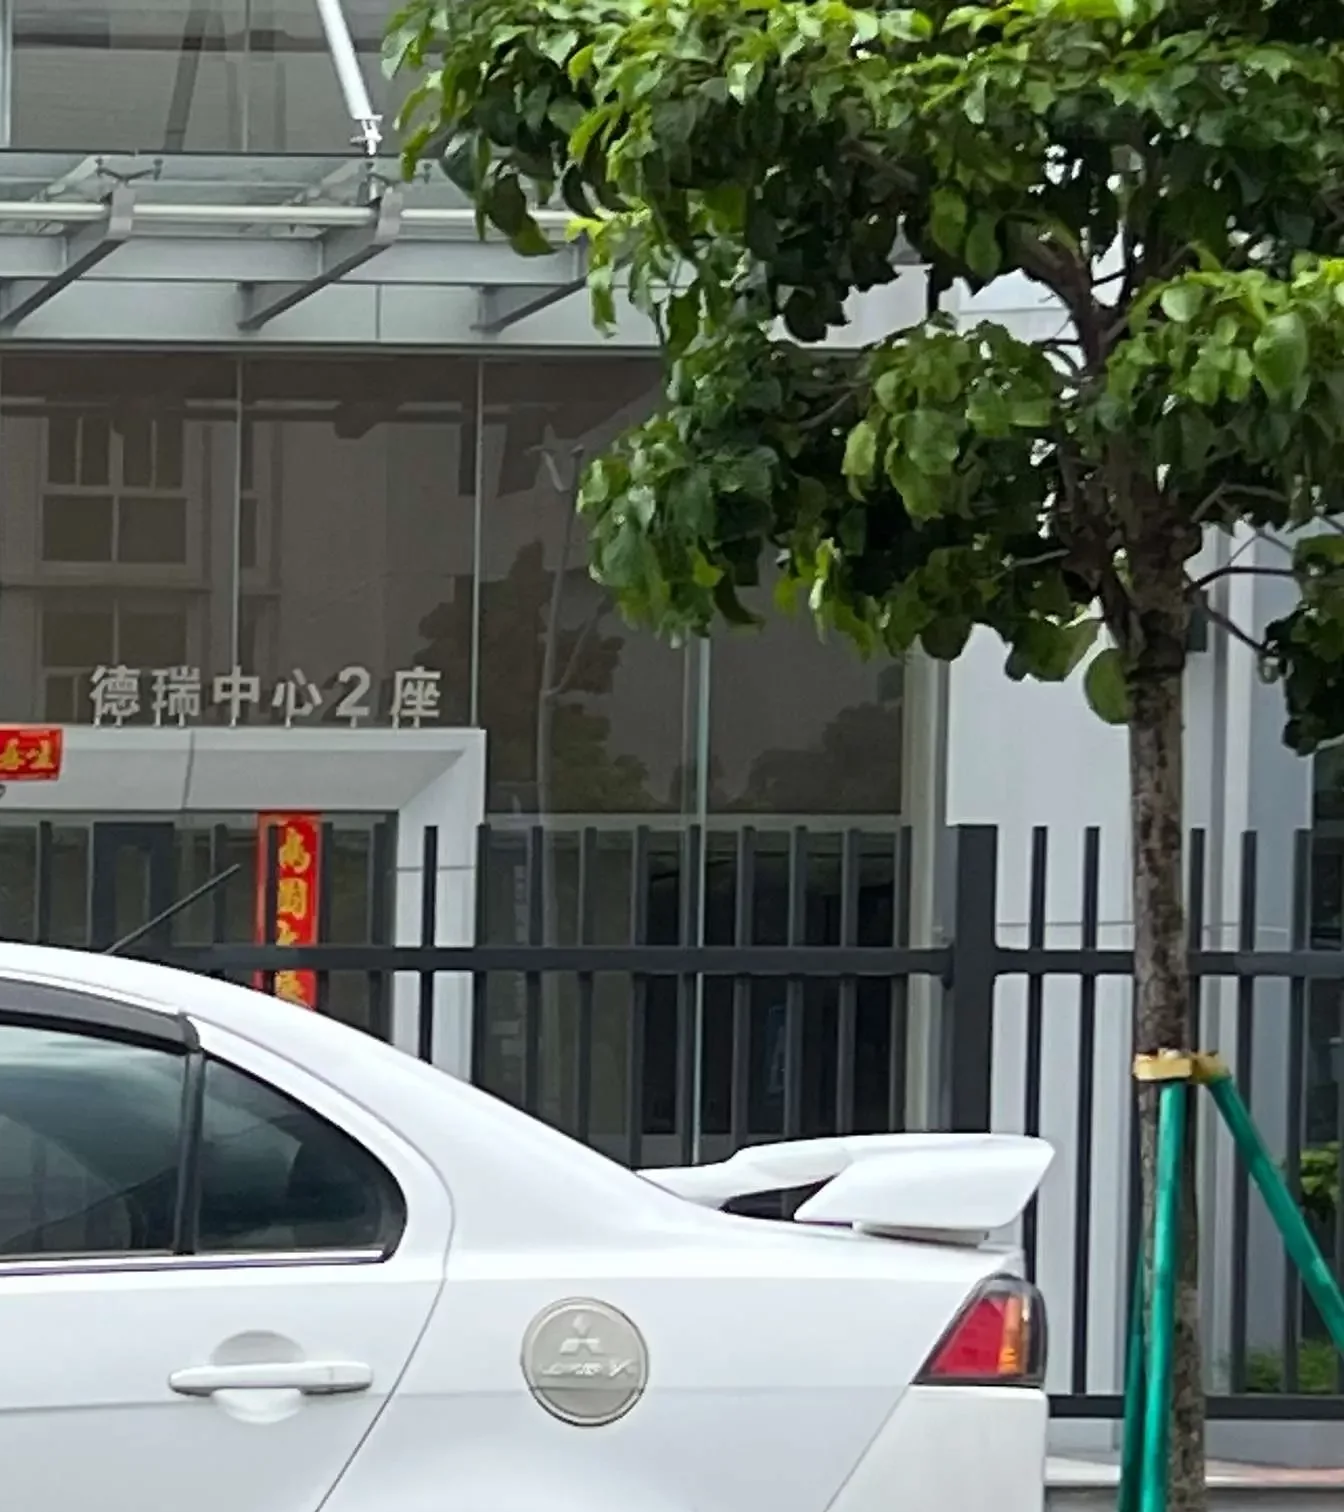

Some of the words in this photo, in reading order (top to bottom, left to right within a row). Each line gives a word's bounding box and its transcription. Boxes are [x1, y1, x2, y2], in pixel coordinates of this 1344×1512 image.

[89, 664, 442, 718] 德瑞中心2座
